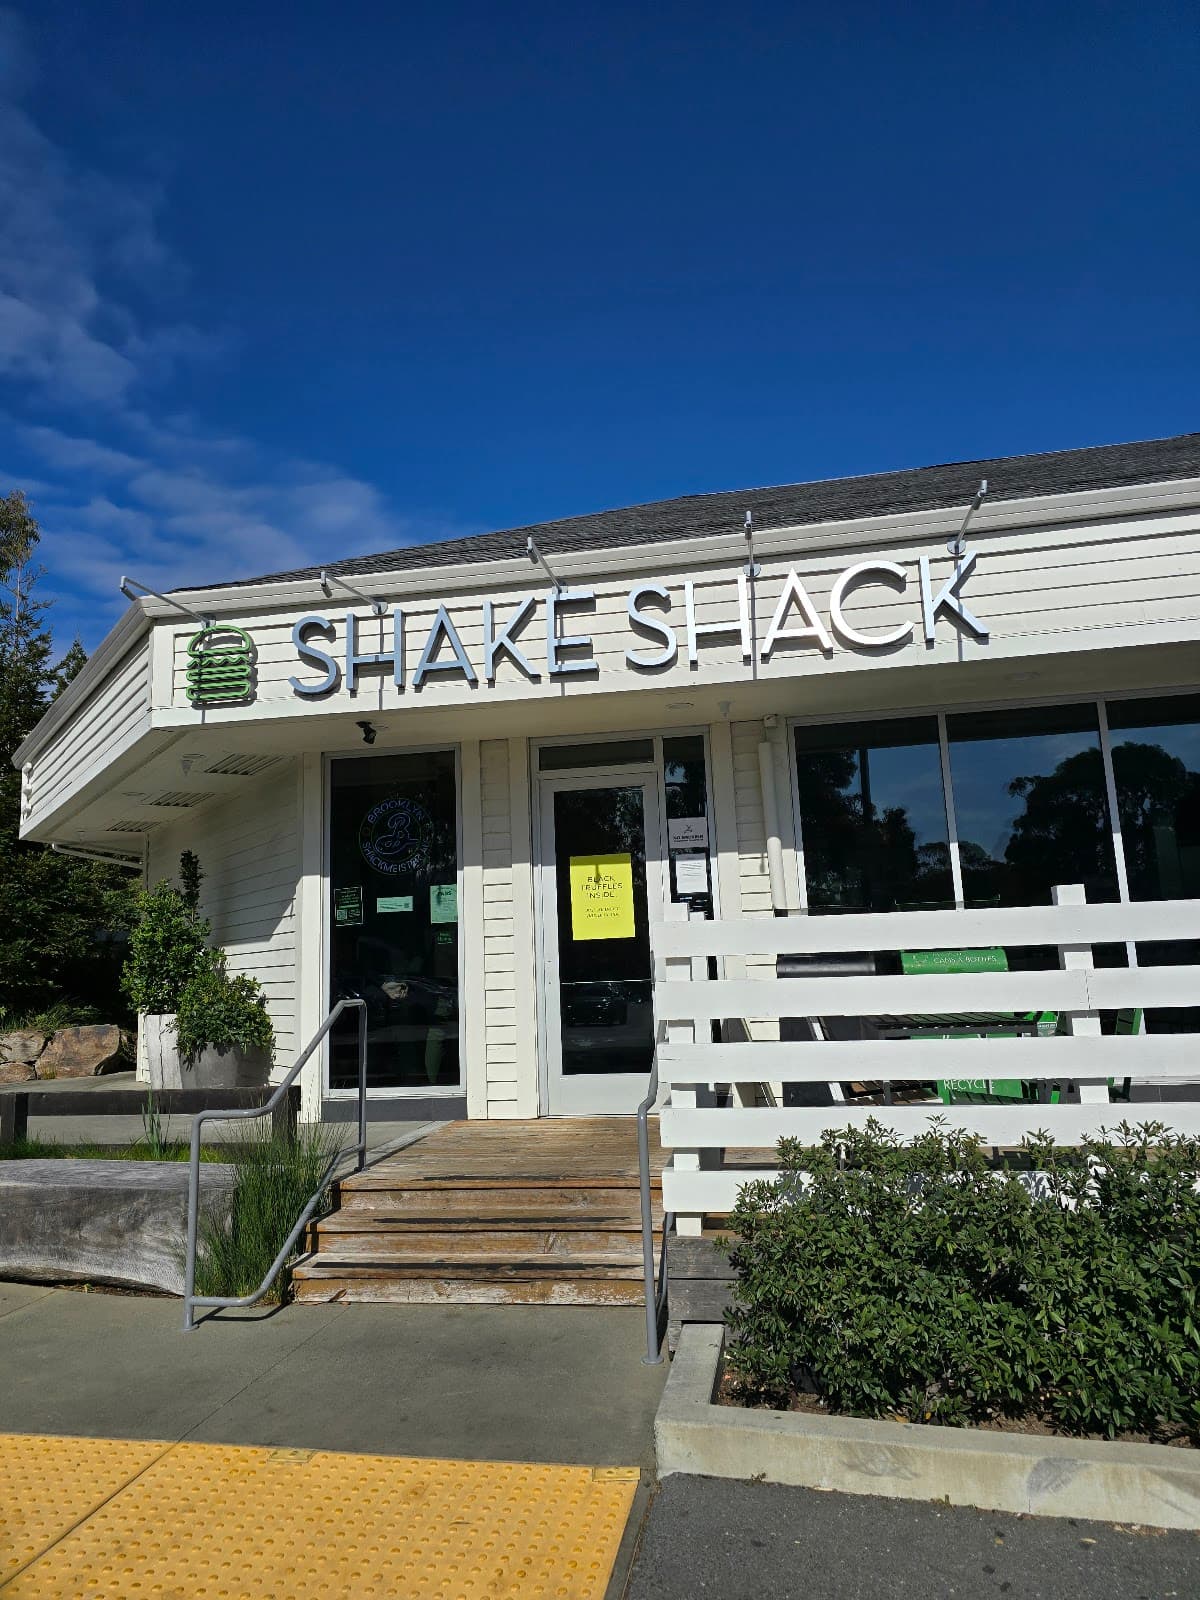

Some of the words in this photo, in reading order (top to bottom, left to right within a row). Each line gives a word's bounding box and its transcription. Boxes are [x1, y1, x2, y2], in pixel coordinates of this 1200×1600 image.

[288, 591, 599, 694] SHAKE
[625, 551, 989, 668] SHACK
[587, 875, 615, 883] BLACK
[581, 882, 623, 891] TRUFFLES
[943, 1079, 995, 1090] RECYCLE
